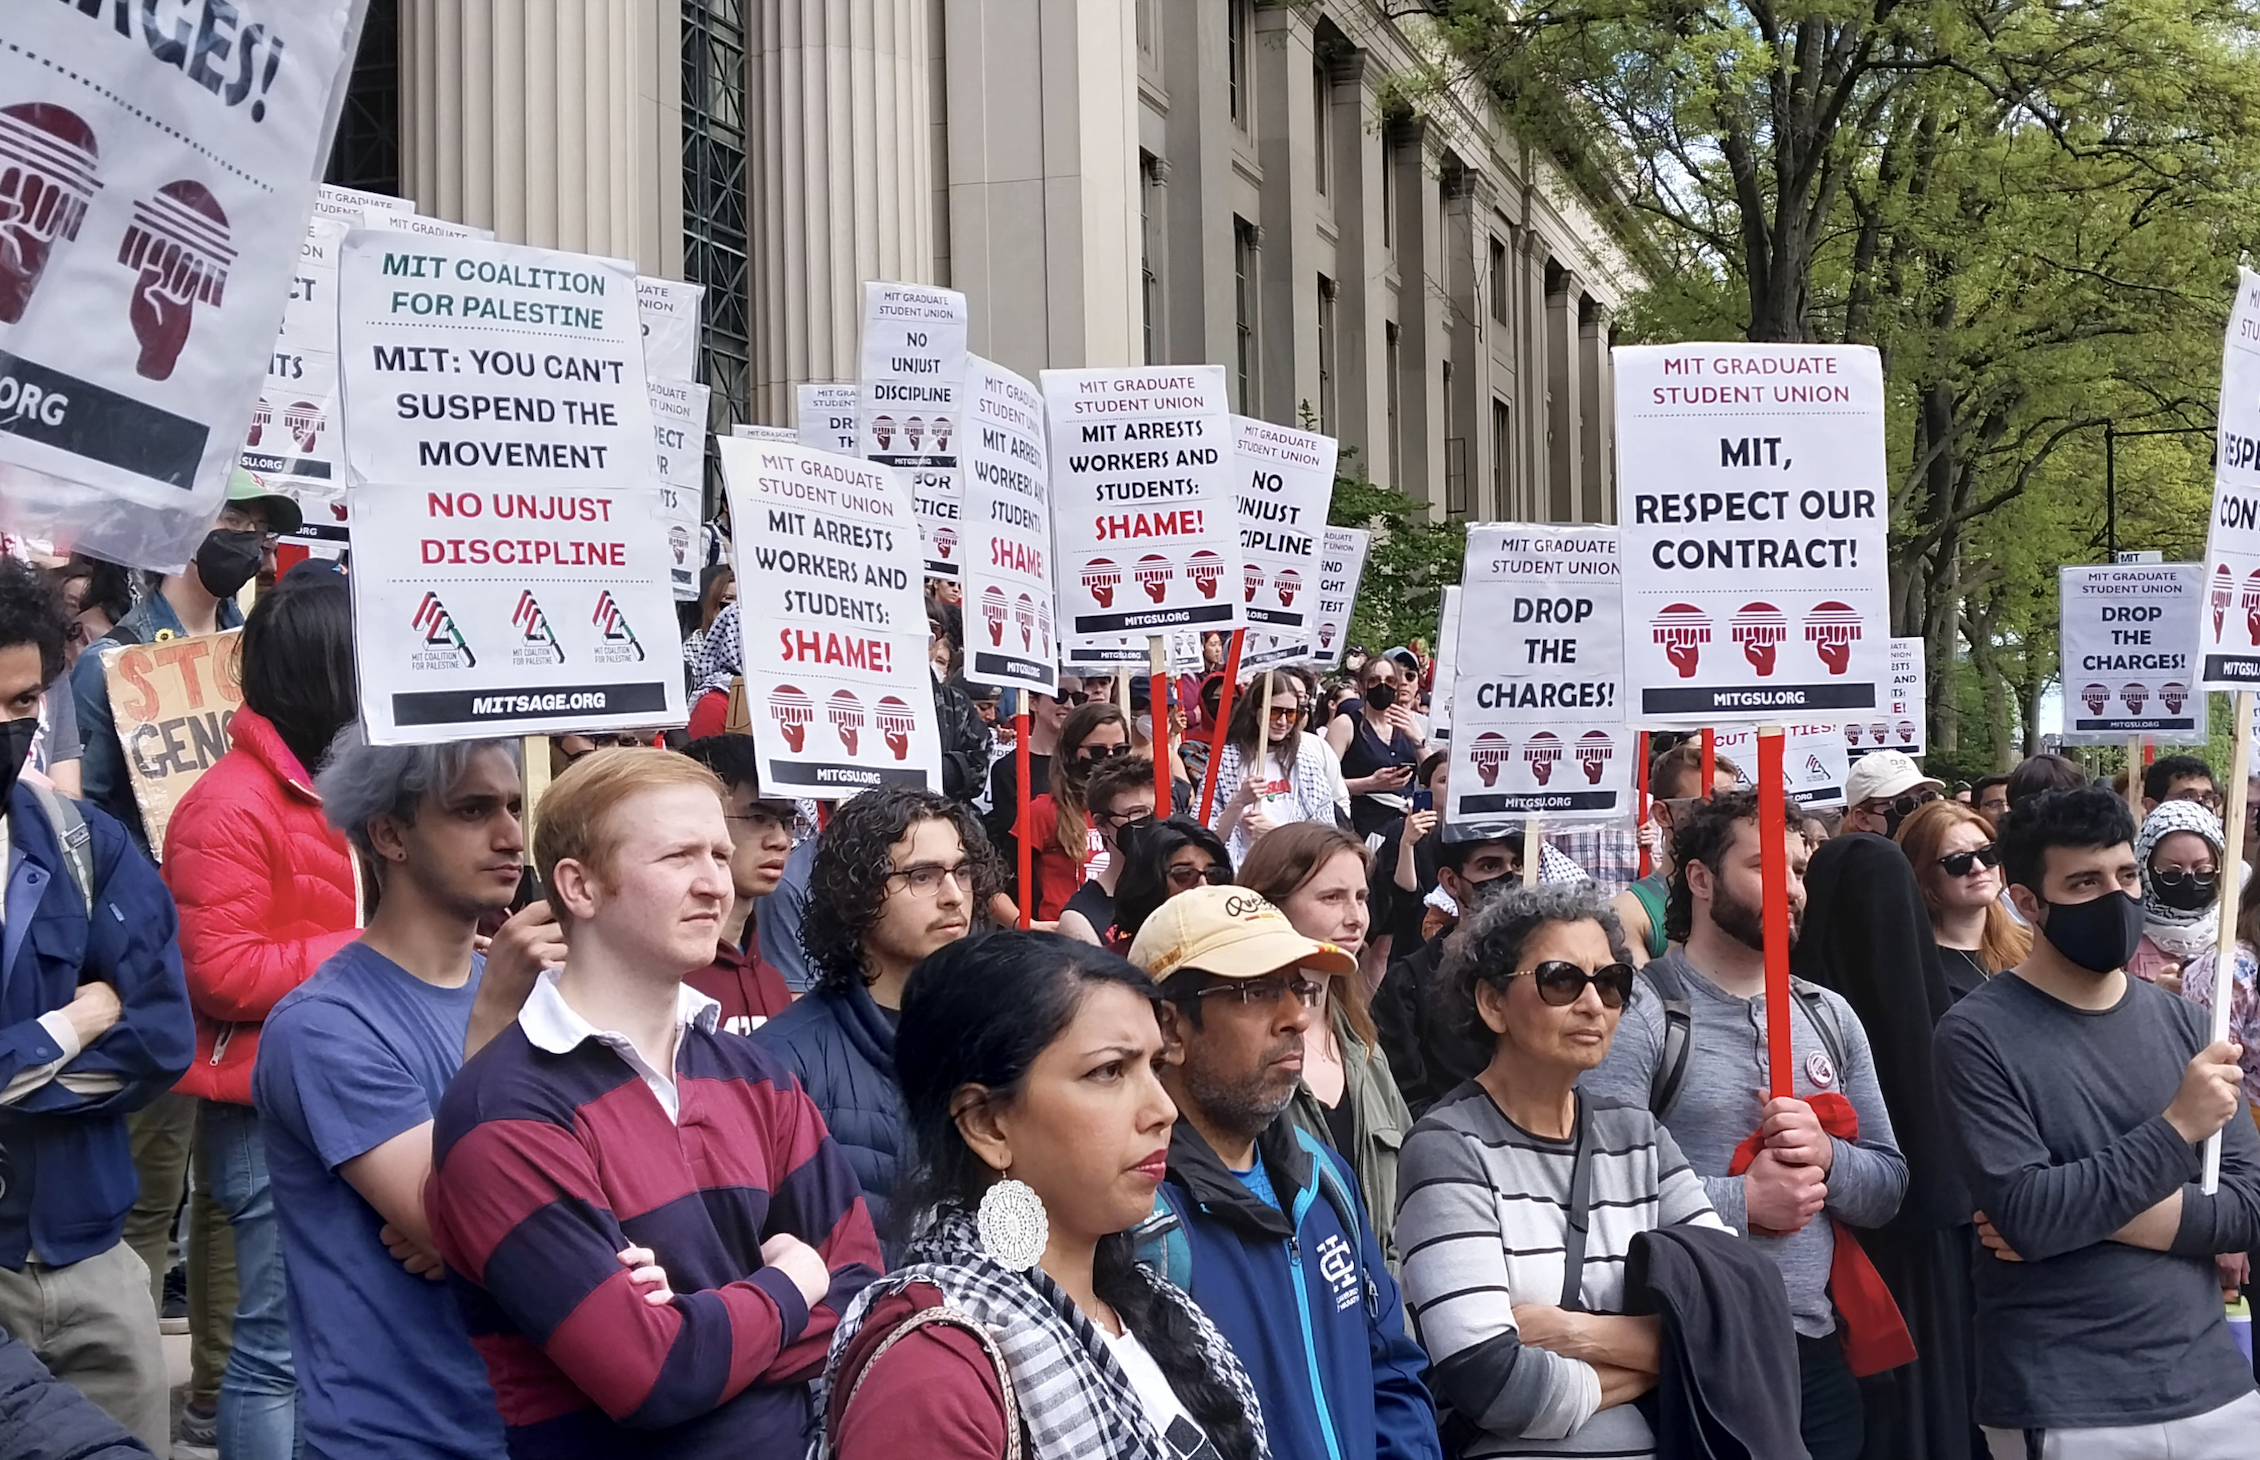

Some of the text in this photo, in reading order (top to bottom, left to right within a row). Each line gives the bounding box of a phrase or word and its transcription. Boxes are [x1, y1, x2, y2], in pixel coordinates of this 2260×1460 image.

[58, 0, 284, 123] GES!
[390, 217, 408, 230] MIT
[382, 252, 606, 296] MIT COALITION
[639, 299, 674, 312] NION
[884, 292, 949, 305] MIT GRADUATE
[391, 291, 604, 331] FOR PALESTINE
[879, 306, 953, 319] STUDENT UNION
[907, 332, 928, 347] NO
[373, 345, 624, 385] MIT: YOU CAN'T
[892, 357, 941, 374] UNJUST
[1664, 358, 1837, 375] MIT GRADUATE
[647, 382, 687, 400] RADUATE
[817, 389, 834, 397] MIT
[875, 385, 951, 402] DISCIPLINE
[985, 376, 1004, 395] MIT
[1079, 377, 1195, 393] MIT GRADUATE
[1653, 385, 1849, 404] STUDENT UNION
[396, 393, 618, 427] SUSPEND THE
[980, 398, 1025, 427] STUDENT
[1075, 396, 1204, 414] STUDENT UNION
[983, 428, 1006, 453] MIT
[1082, 420, 1203, 442] MIT ARRESTS
[1245, 425, 1317, 451] MIT GRADUATE
[419, 440, 608, 469] MOVEMENT
[1070, 448, 1218, 473] WORKERS AND
[1237, 440, 1320, 466] STUDENT UNION
[1720, 437, 1792, 471] MIT,
[762, 454, 884, 491] MIT GRADUATE
[975, 460, 1032, 497] WORKERS
[1252, 470, 1283, 493] NO
[759, 478, 894, 517] STUDENT UNION
[1096, 478, 1200, 502] STUDENTS:
[427, 492, 613, 523] NO UNJUST
[1635, 490, 1875, 524] RESPECT OUR
[769, 509, 893, 552] MIT ARRESTS
[1095, 510, 1204, 541] SHAME!
[1323, 532, 1353, 542] ADUATE
[1330, 543, 1354, 552] UNION
[1501, 539, 1616, 553] MIT GRADUATE
[421, 538, 626, 567] DISCIPLINE
[1652, 538, 1858, 570] CONTRACT!
[2121, 553, 2140, 563] MIT
[756, 547, 908, 590] WORKERS AND
[1491, 560, 1620, 575] STUDENT UNION
[2088, 572, 2176, 581] MIT GRADUATE
[2082, 585, 2182, 594] STUDENT UNION
[785, 589, 890, 625] STUDENTS:
[1513, 598, 1593, 623] DROP
[2102, 606, 2162, 622] DROP
[1125, 611, 1190, 626] MITGSU.ORG
[2111, 630, 2152, 645] THE
[780, 628, 892, 673] SHAME!
[1525, 639, 1577, 664] THE
[2083, 654, 2186, 671] CHARGES!
[119, 636, 244, 721] STO
[1894, 675, 1917, 684] AND
[472, 692, 606, 715] MITSAGE.ORG
[1477, 682, 1615, 709] CHARGES!
[1714, 691, 1805, 707] MITGSU.ORG
[1714, 733, 1748, 747] CUT
[817, 769, 881, 785] MITGSU.ORG
[1505, 797, 1571, 808] MITGSU.ORG
